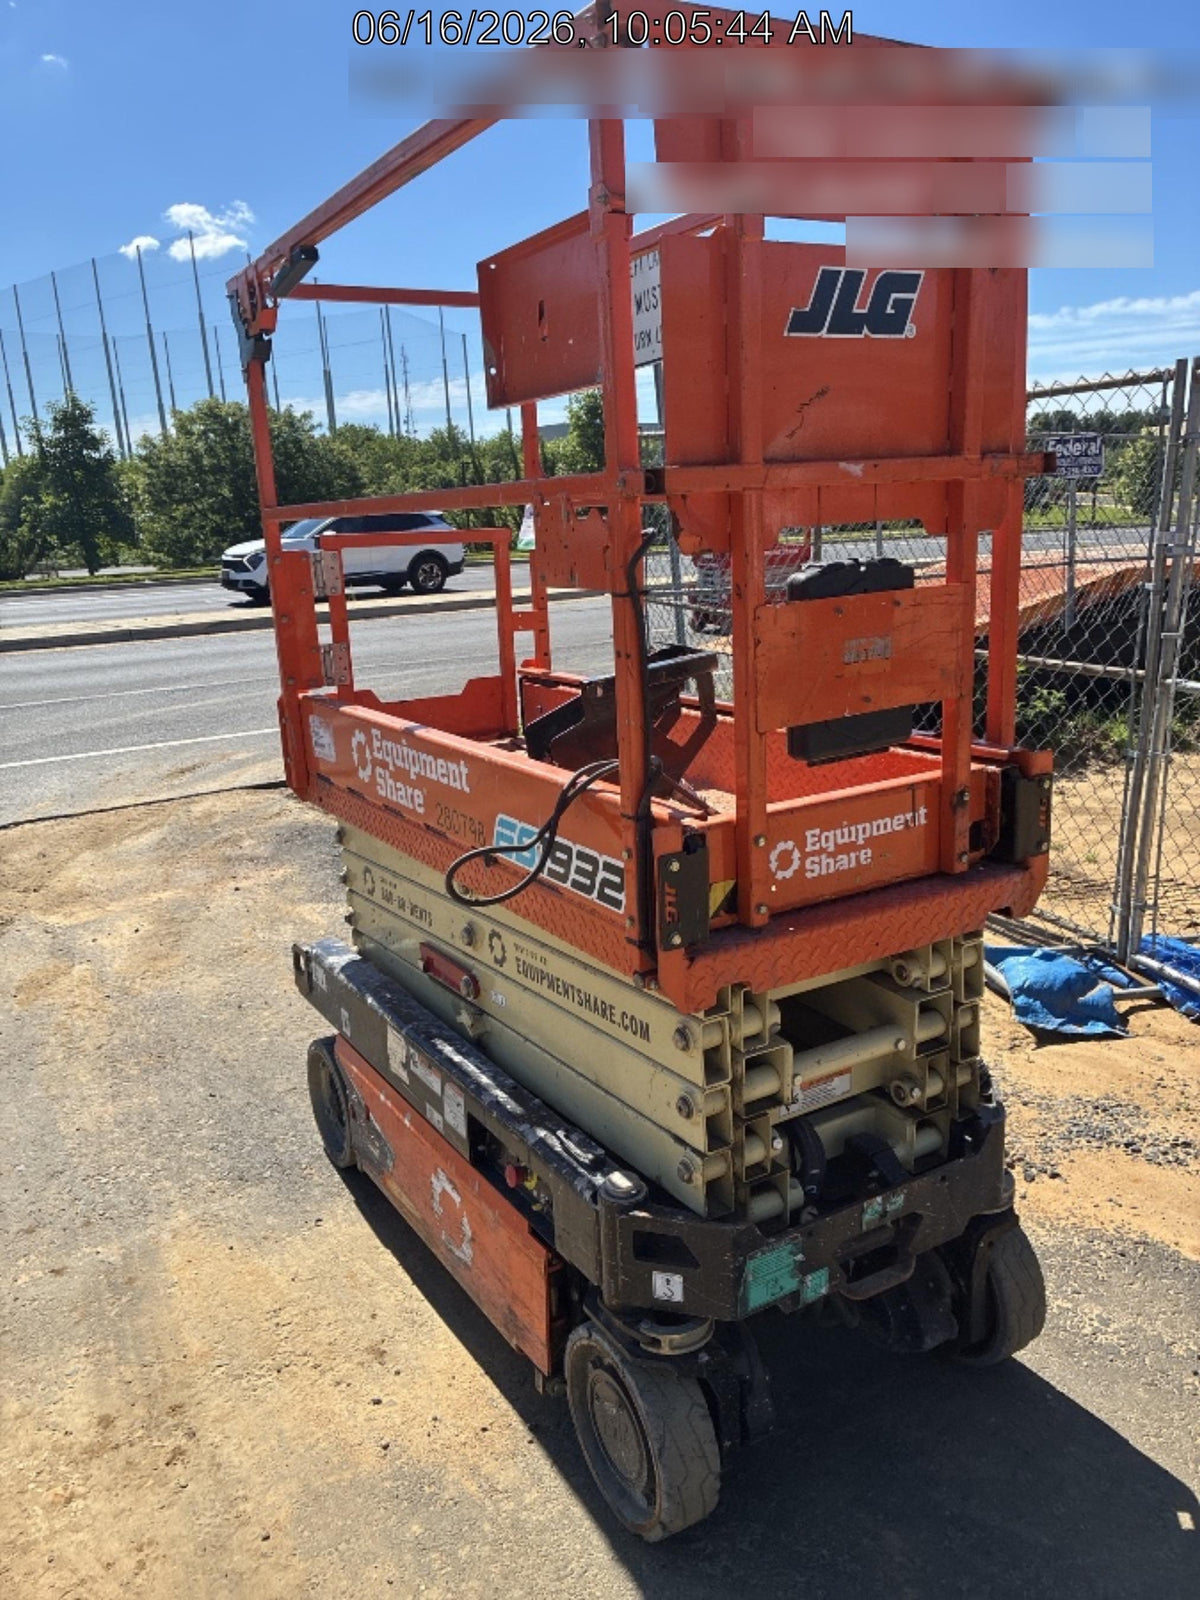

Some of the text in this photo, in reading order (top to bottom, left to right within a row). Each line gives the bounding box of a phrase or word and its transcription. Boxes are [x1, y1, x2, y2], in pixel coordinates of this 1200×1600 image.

[783, 266, 925, 339] JLG
[1047, 437, 1102, 457] Federal
[371, 728, 471, 794] Equipment
[375, 766, 425, 815] Share
[804, 805, 928, 853] Equipment
[804, 847, 873, 880] Share
[664, 881, 680, 924] JLG
[514, 955, 652, 1044] EQUIPMENTSHARE.COM
